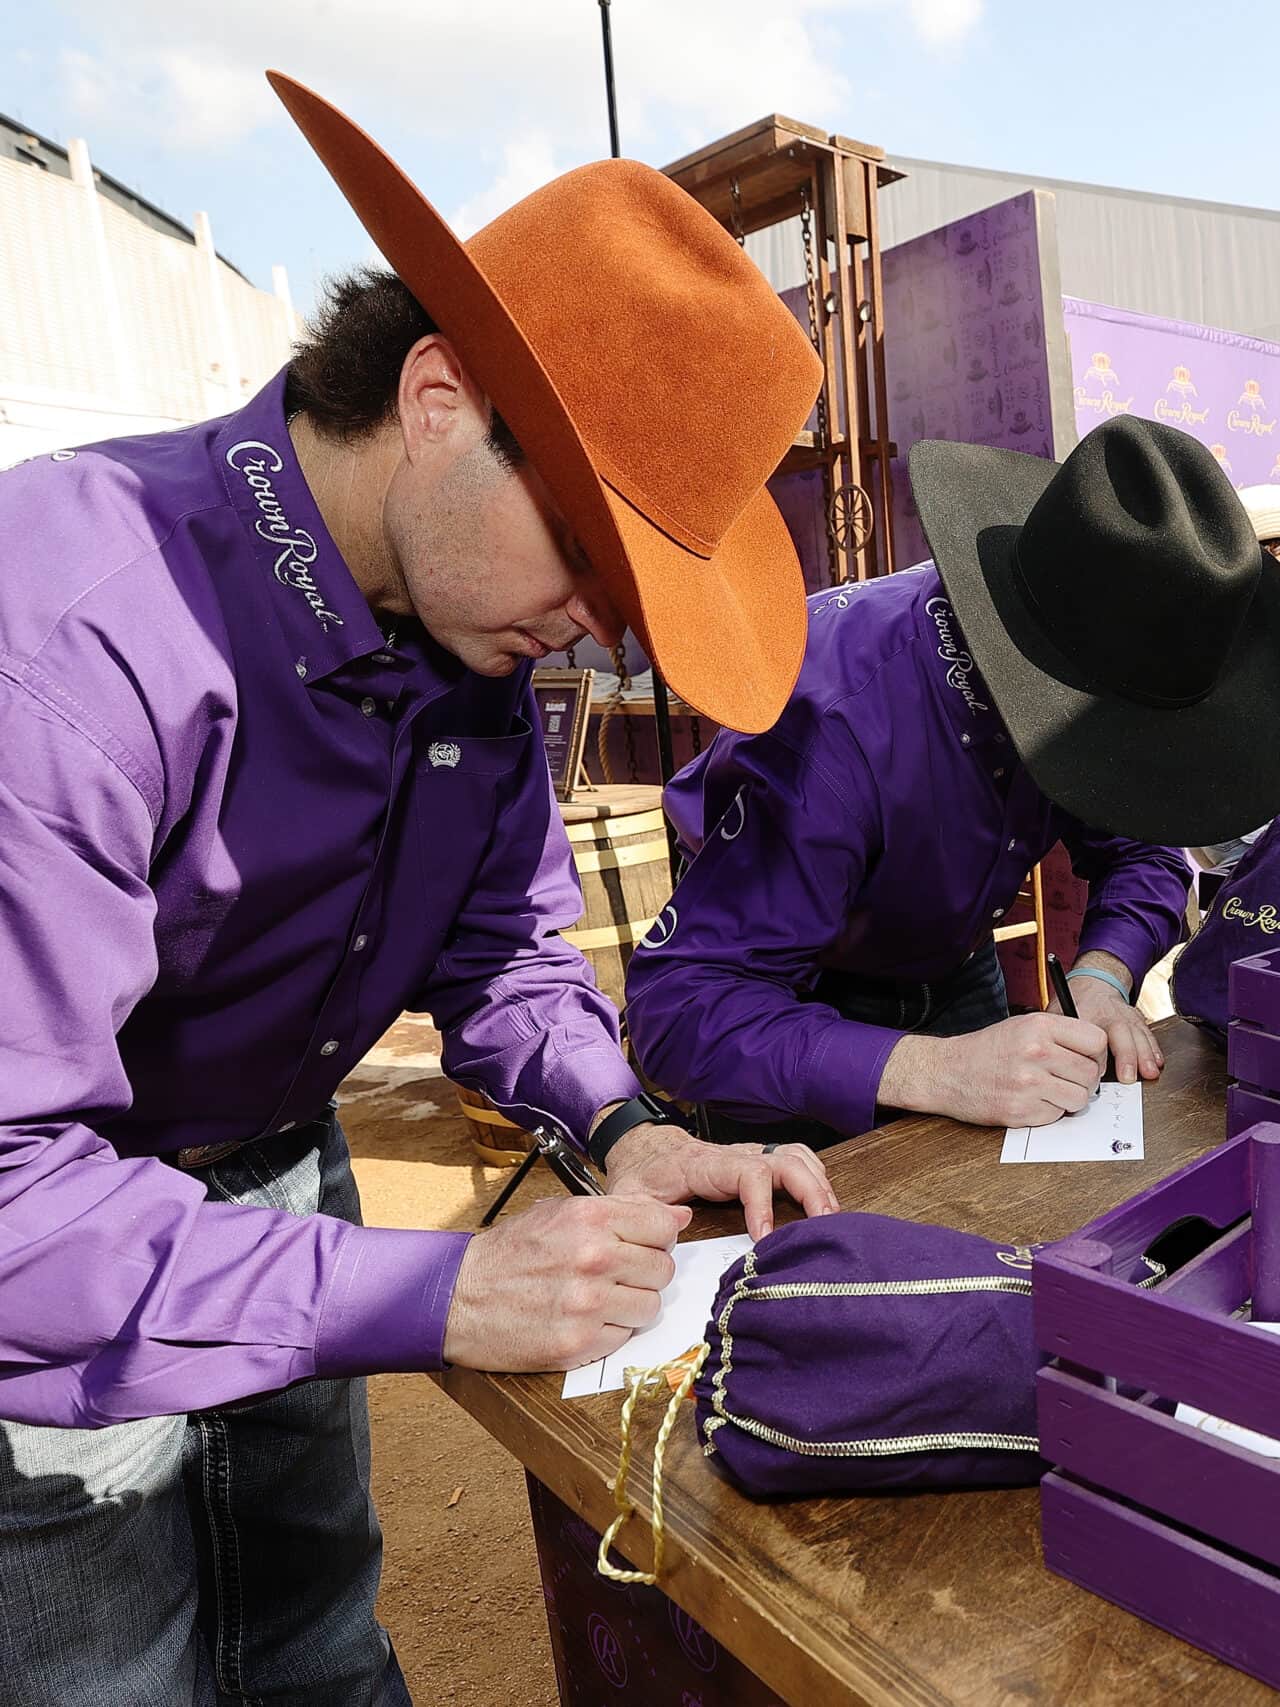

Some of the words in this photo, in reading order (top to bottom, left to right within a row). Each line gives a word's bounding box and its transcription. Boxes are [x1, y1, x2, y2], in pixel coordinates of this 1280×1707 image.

[227, 440, 290, 533] Crown
[256, 524, 344, 629] Royal
[925, 597, 957, 656] Crown
[938, 646, 988, 712] Royal
[1222, 897, 1255, 920] Crown
